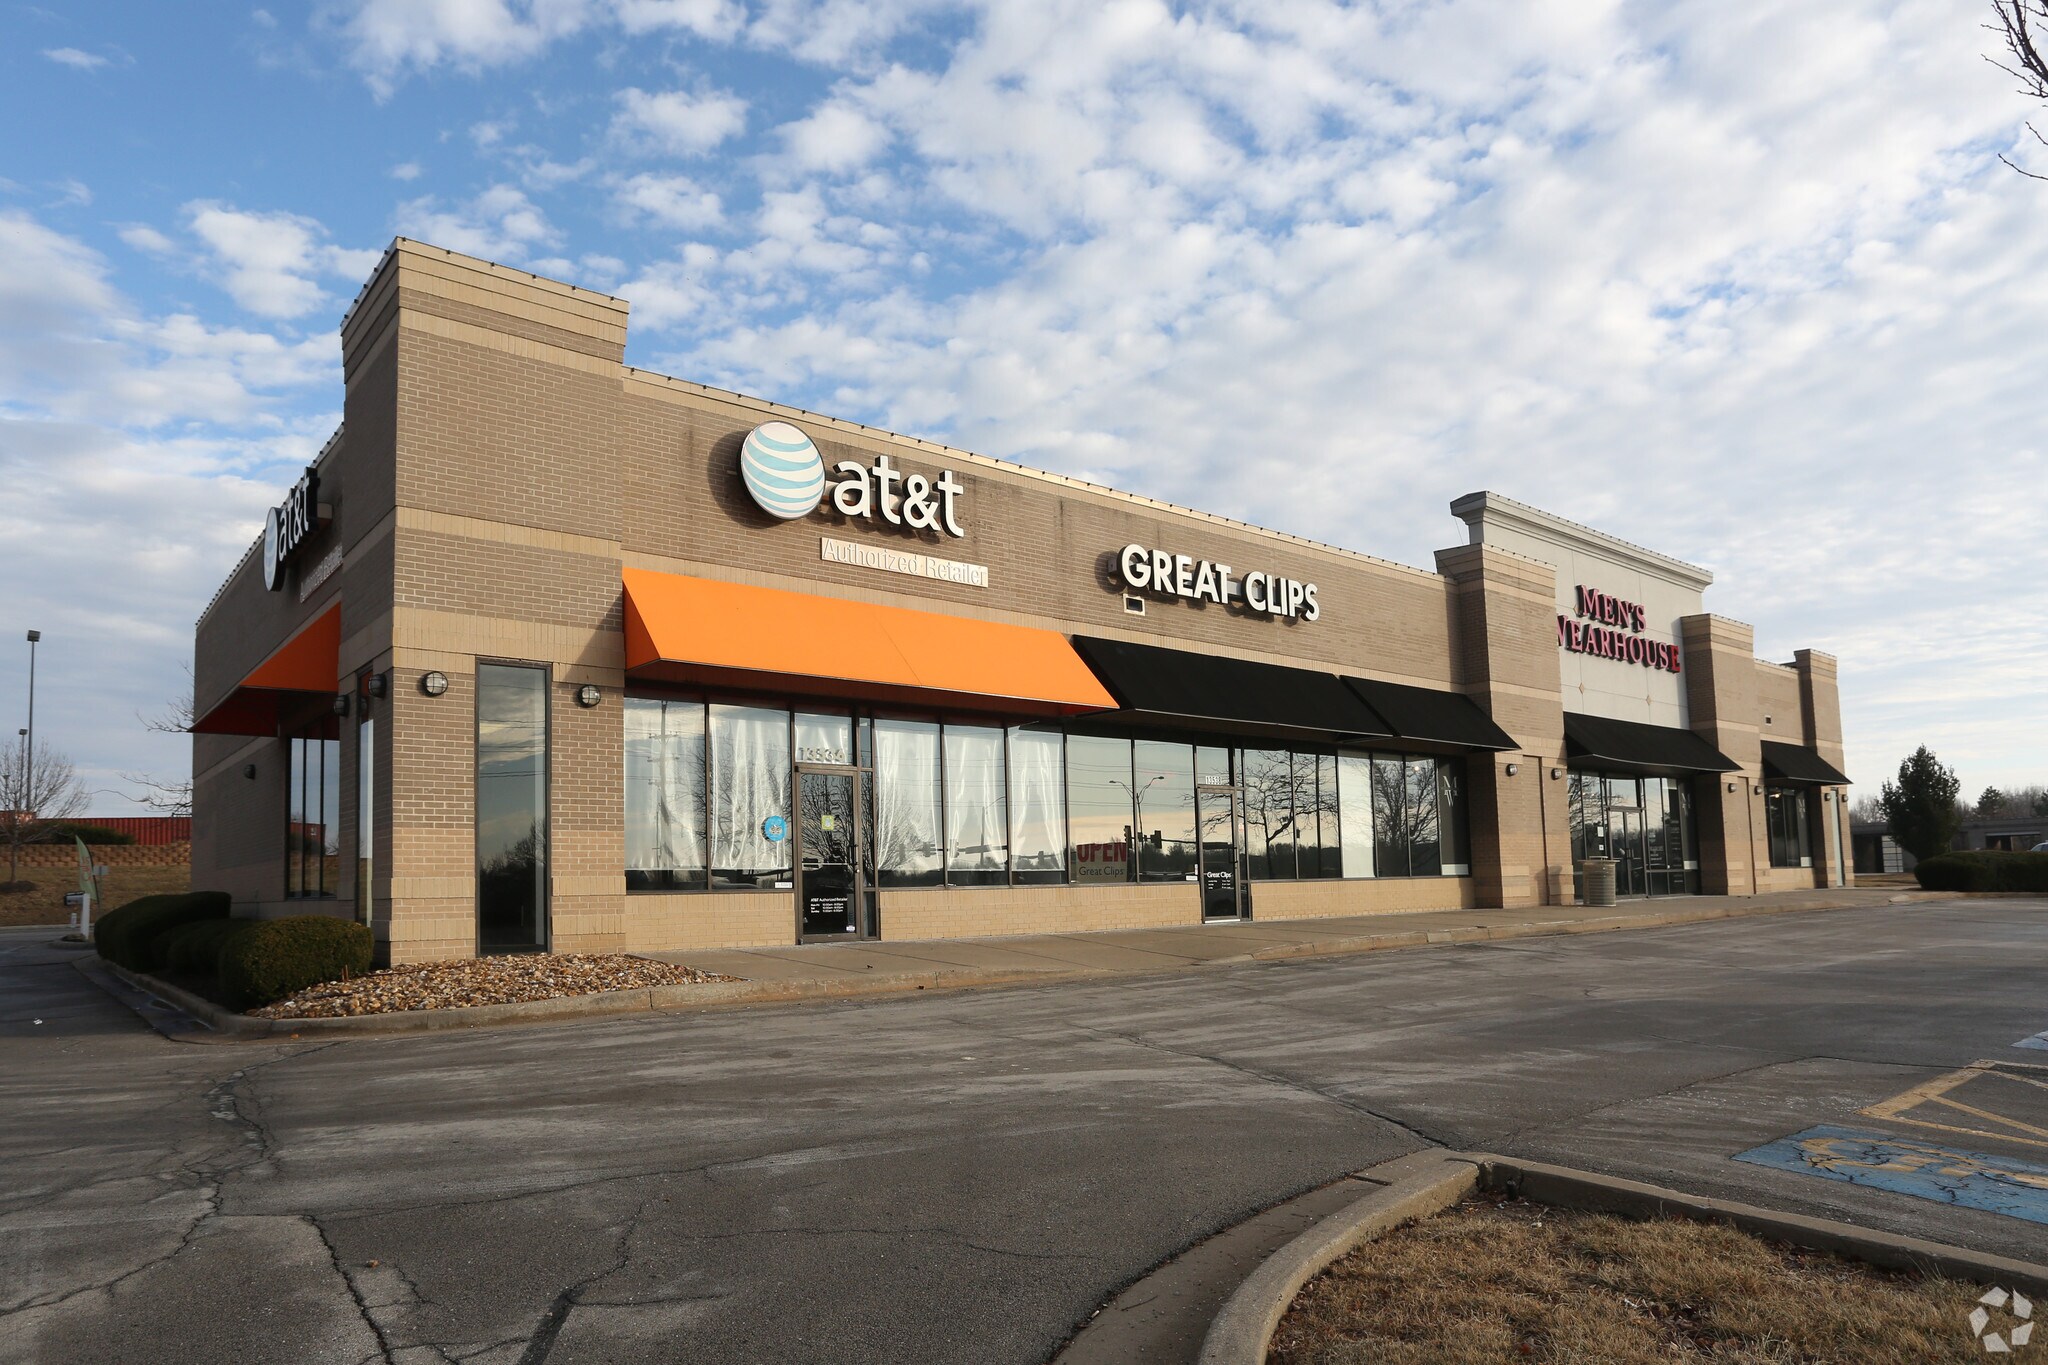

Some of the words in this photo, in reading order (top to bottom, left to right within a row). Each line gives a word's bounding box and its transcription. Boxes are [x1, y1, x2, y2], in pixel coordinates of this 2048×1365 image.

[278, 466, 311, 562] at&t
[832, 455, 964, 537] at&t
[823, 538, 918, 575] Authorized
[925, 556, 987, 586] Retailer
[1121, 543, 1232, 604] GREAT
[1245, 571, 1320, 621] CLIPS
[1577, 585, 1647, 632] MEN'S
[1077, 843, 1127, 863] OPEN
[1079, 866, 1102, 876] Great
[1104, 866, 1124, 878] Clips
